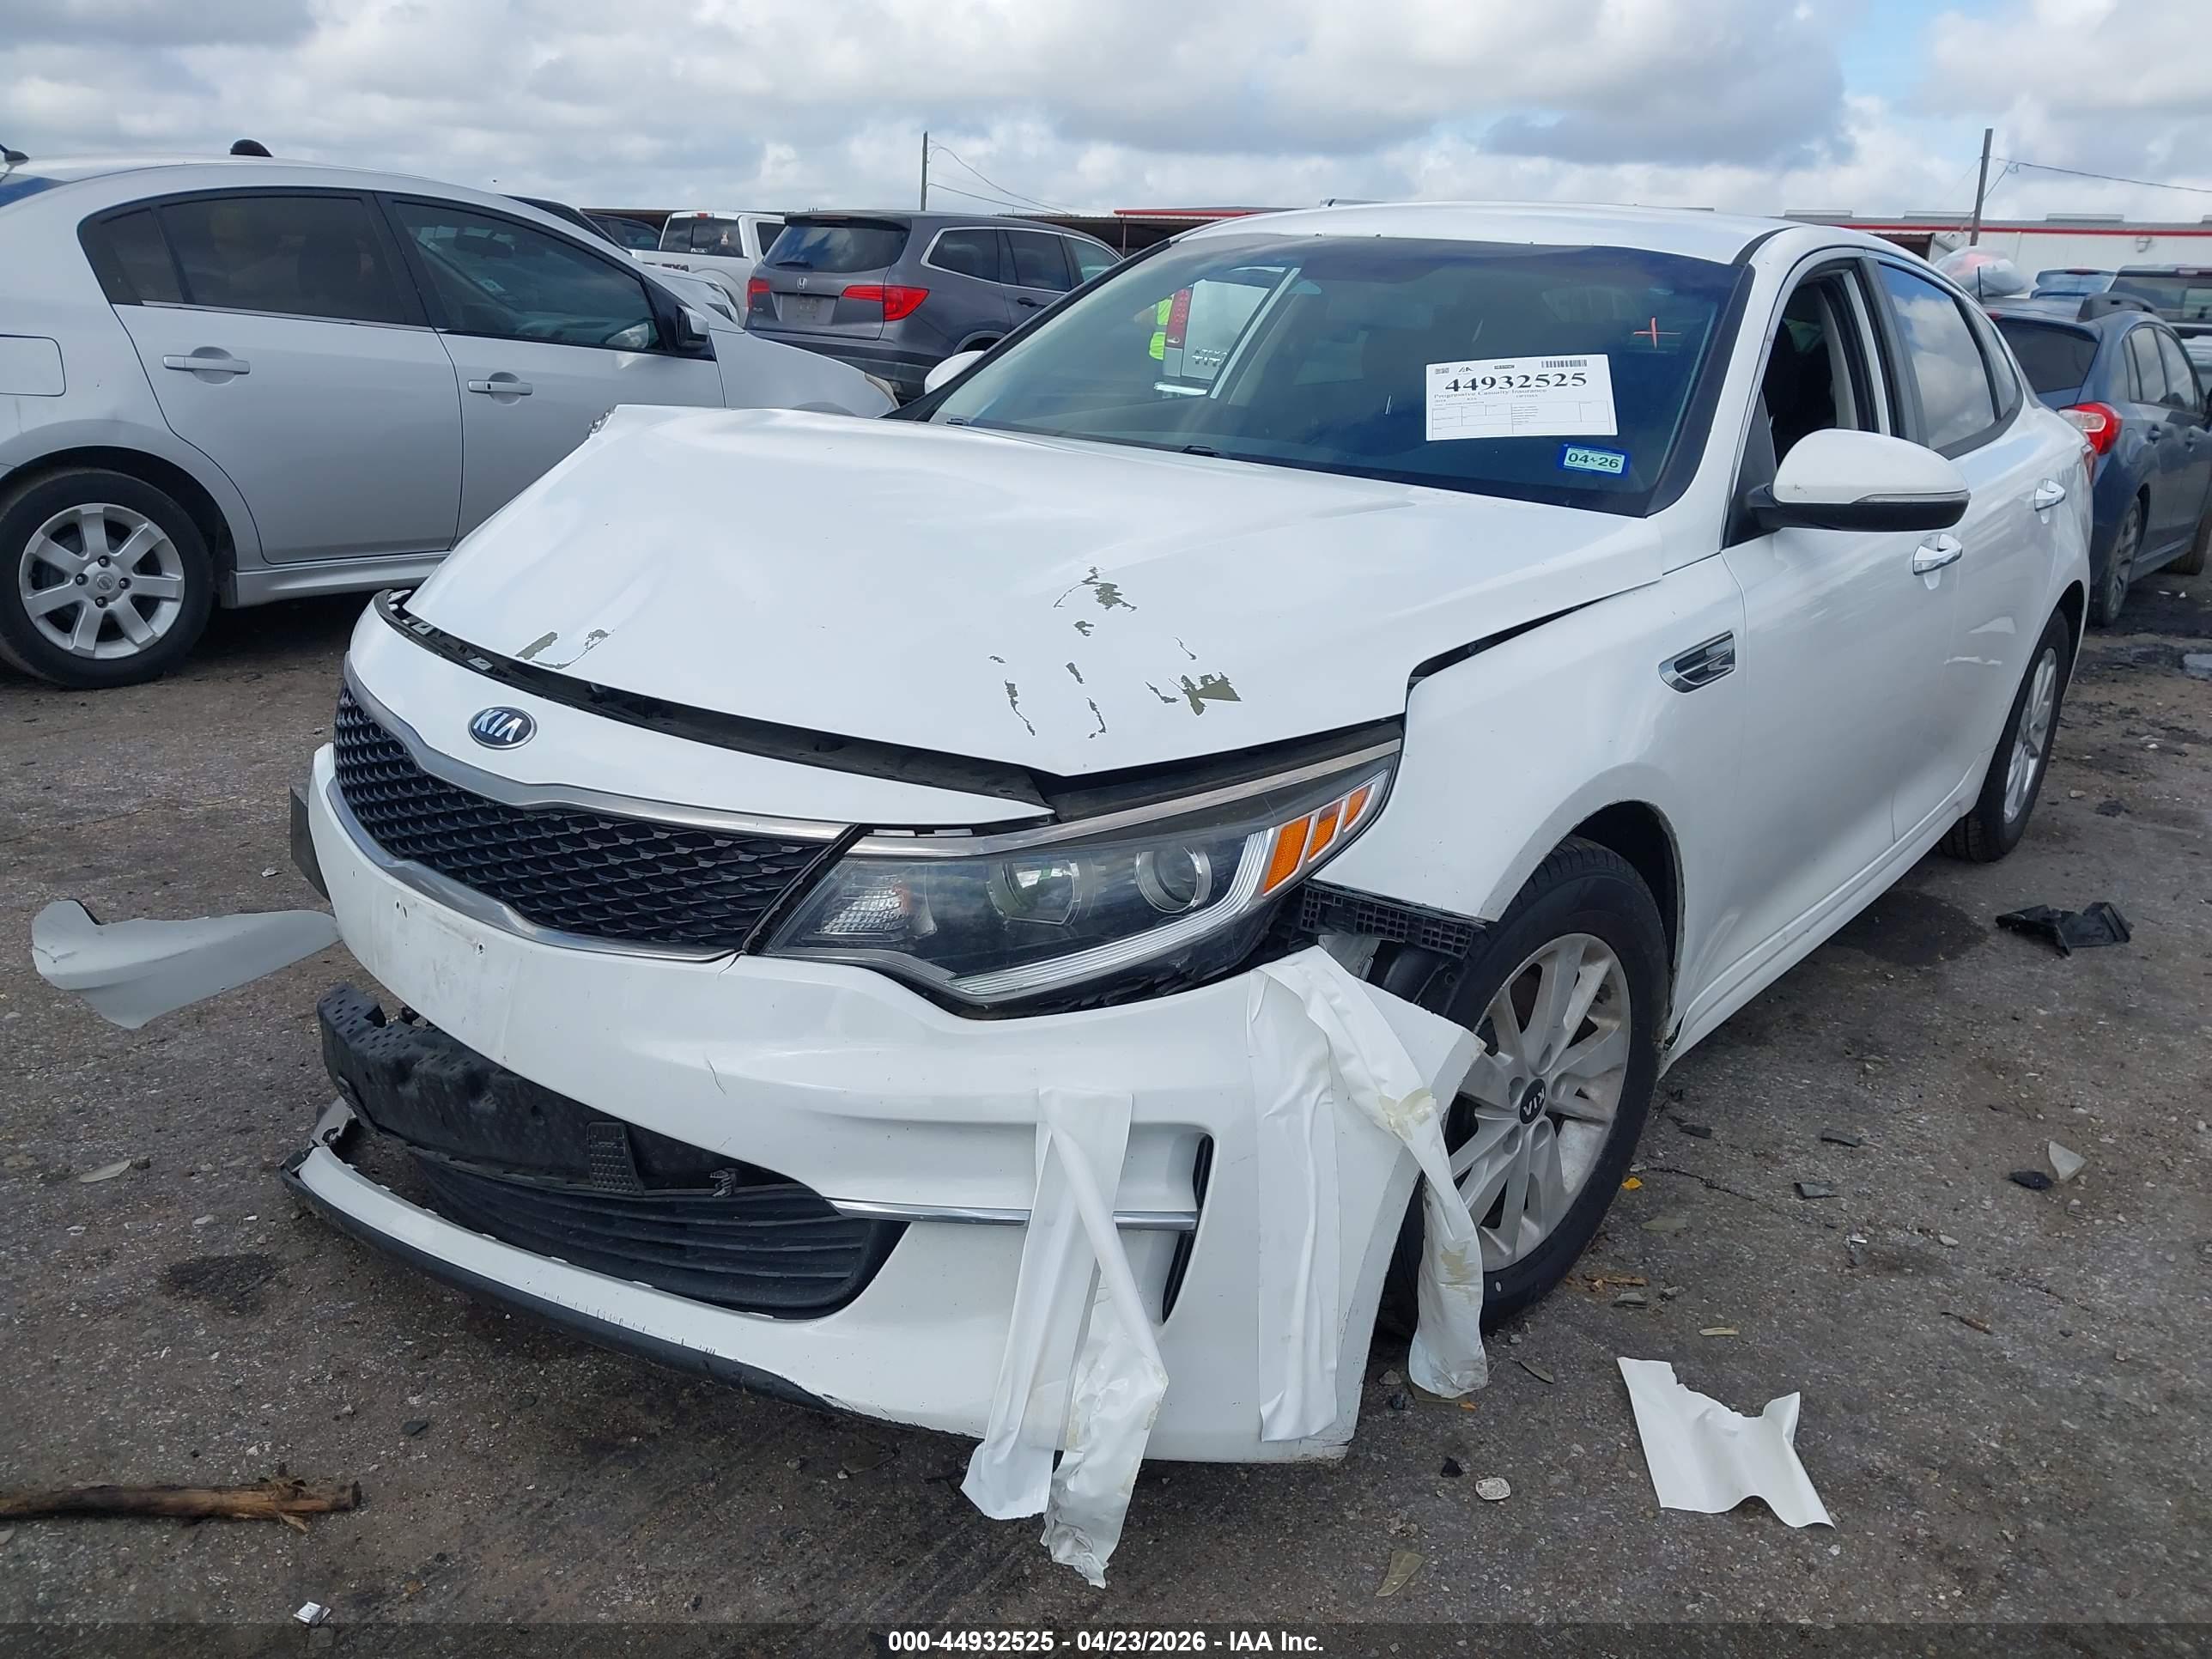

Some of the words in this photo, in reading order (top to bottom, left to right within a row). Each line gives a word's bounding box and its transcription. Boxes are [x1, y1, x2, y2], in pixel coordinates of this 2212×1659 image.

[1445, 373, 1587, 392] 44932525
[1568, 453, 1589, 464] 04
[1597, 457, 1620, 468] 26
[473, 709, 523, 742] KIA
[1522, 1087, 1545, 1115] KIA
